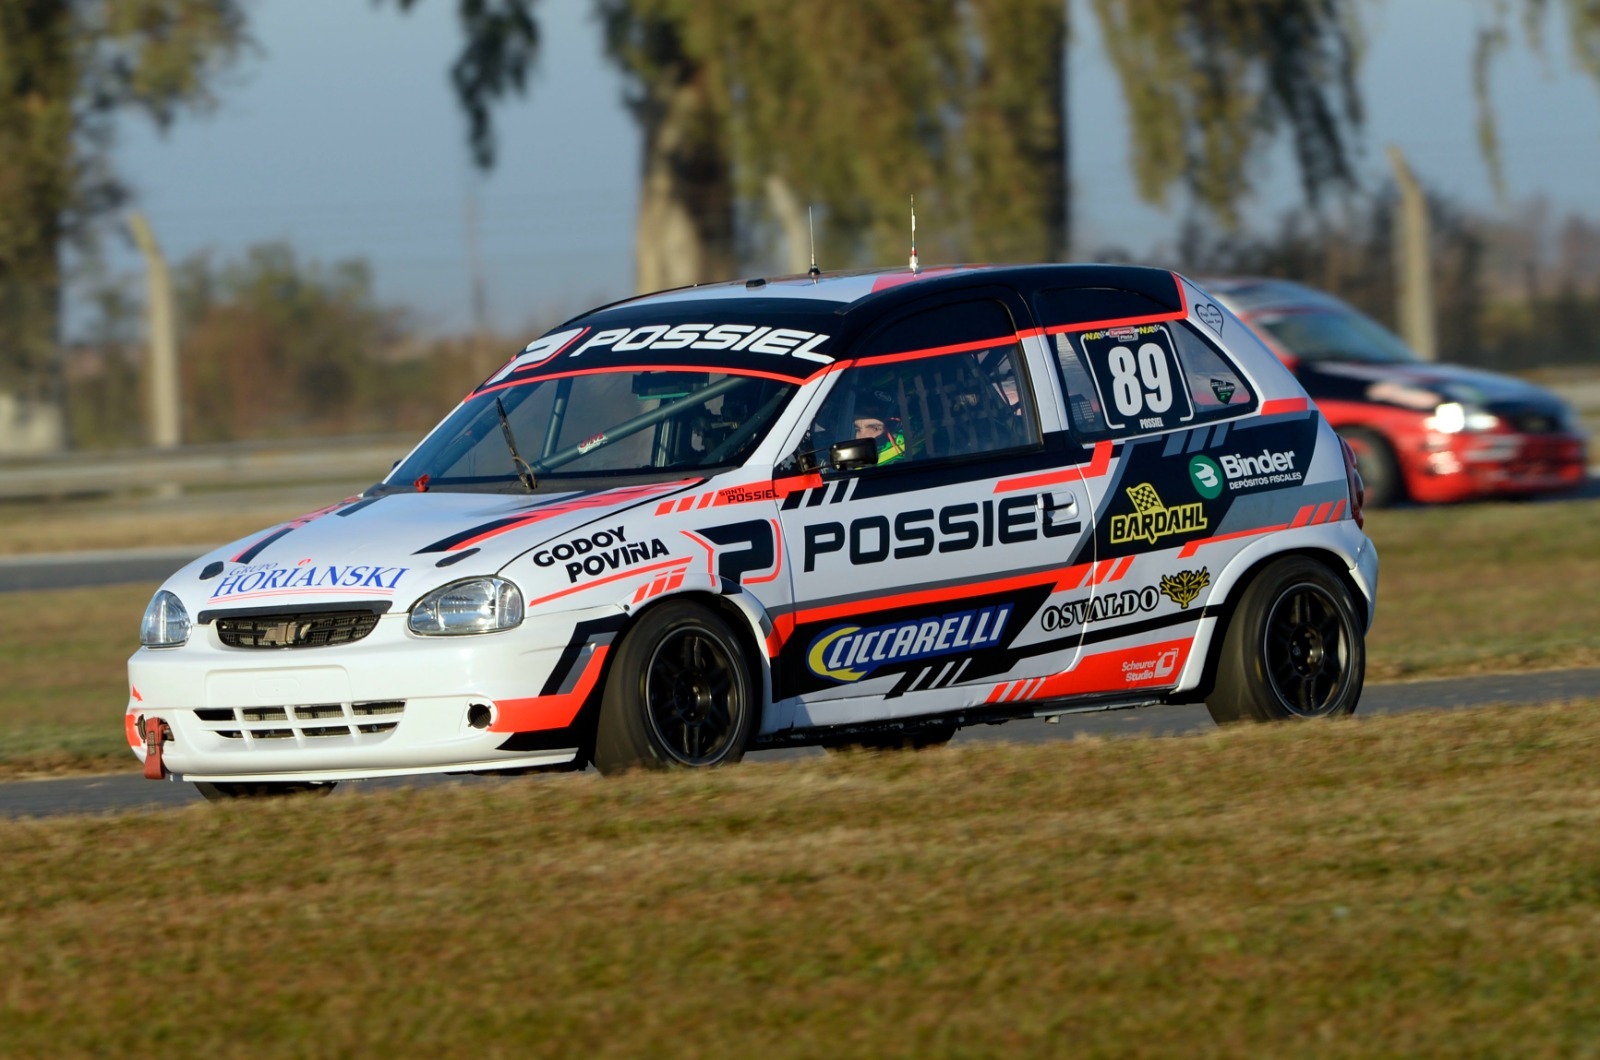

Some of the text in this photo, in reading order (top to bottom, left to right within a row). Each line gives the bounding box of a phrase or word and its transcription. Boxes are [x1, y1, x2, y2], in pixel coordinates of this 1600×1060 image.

[569, 323, 837, 364] POSSIEL
[1108, 342, 1174, 417] 89
[1139, 416, 1164, 429] POSSIEL
[1219, 449, 1296, 479] Binder
[1228, 471, 1303, 490] DEPÓSITOS FISCALES
[719, 487, 745, 497] SANTI
[727, 489, 780, 504] POSSIEL
[803, 494, 1082, 573] POSSIEL
[1111, 503, 1208, 544] BARDAHL
[533, 526, 625, 567] GODOY
[565, 538, 670, 584] POVIÑA
[211, 565, 410, 598] HORIANSKI
[229, 561, 279, 576] GRUPO
[1041, 585, 1161, 632] OSVALDO
[815, 606, 1010, 676] CICCARELLI
[1121, 660, 1157, 672] Scheurer
[1125, 669, 1154, 682] Studio
